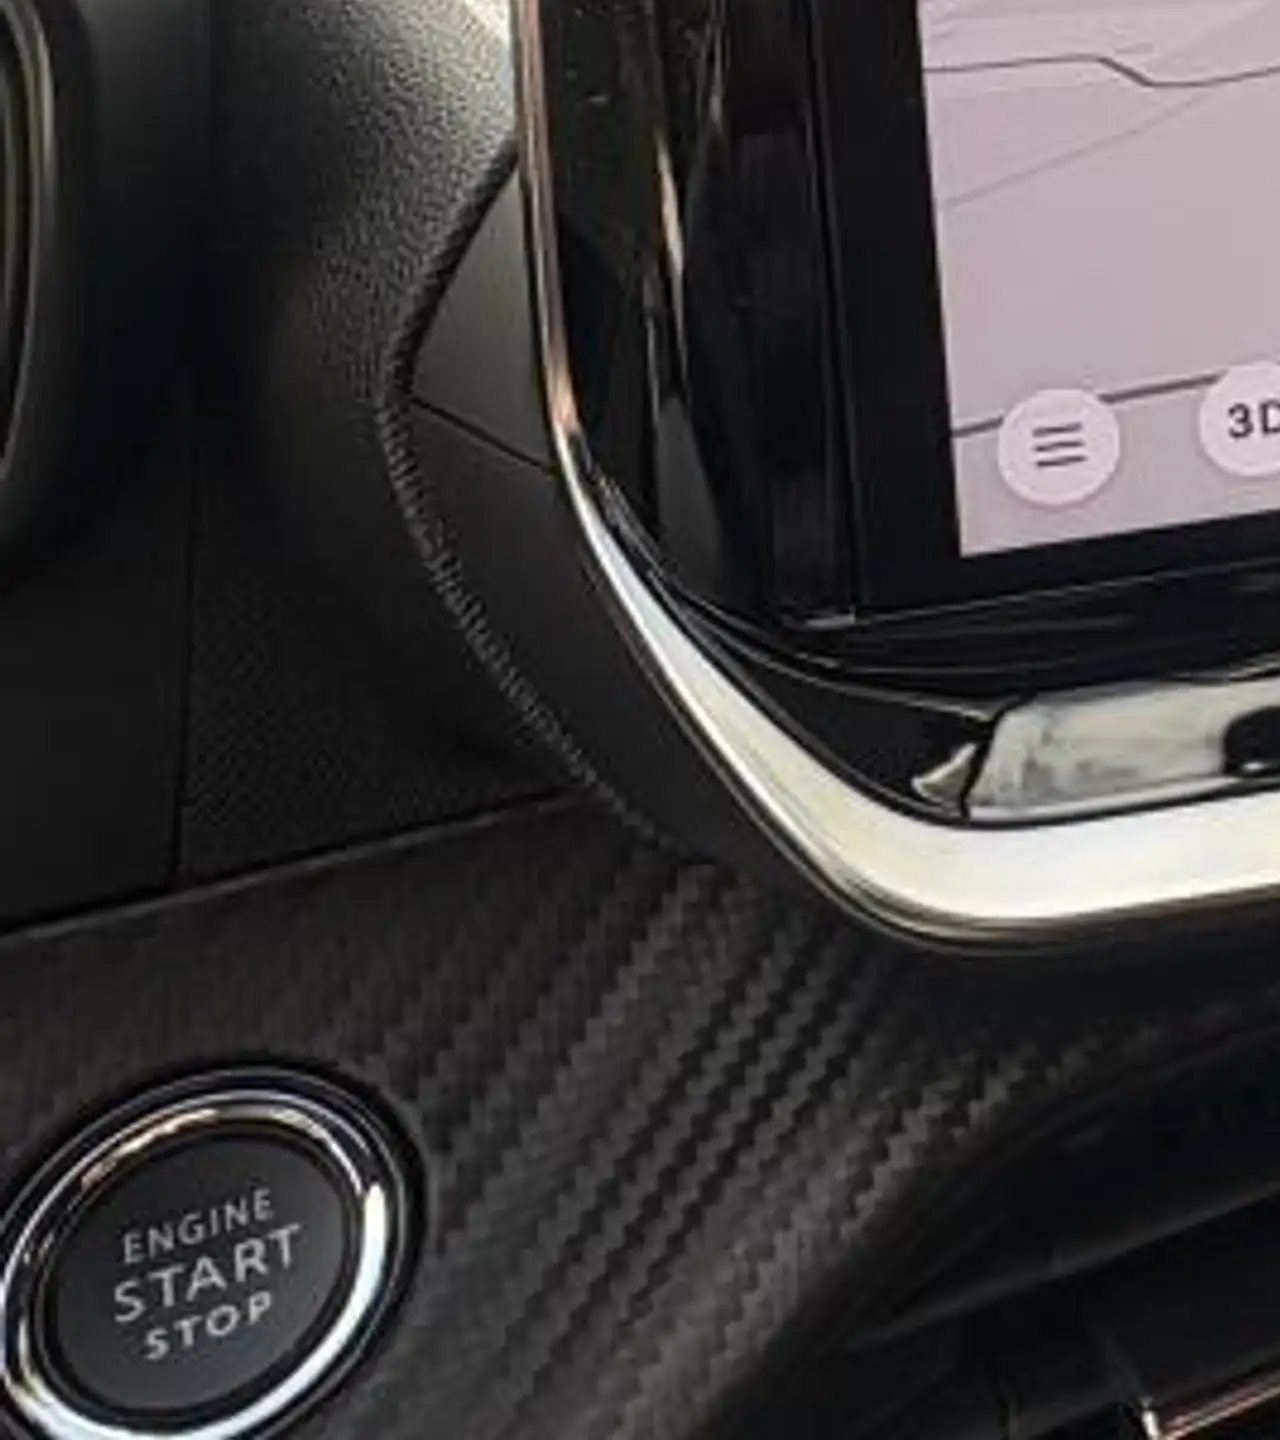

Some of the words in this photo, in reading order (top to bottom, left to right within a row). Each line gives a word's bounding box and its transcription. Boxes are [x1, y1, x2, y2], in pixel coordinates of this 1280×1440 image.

[122, 1188, 275, 1265] ENGINE
[113, 1223, 301, 1324] START
[144, 1292, 273, 1360] STOP
